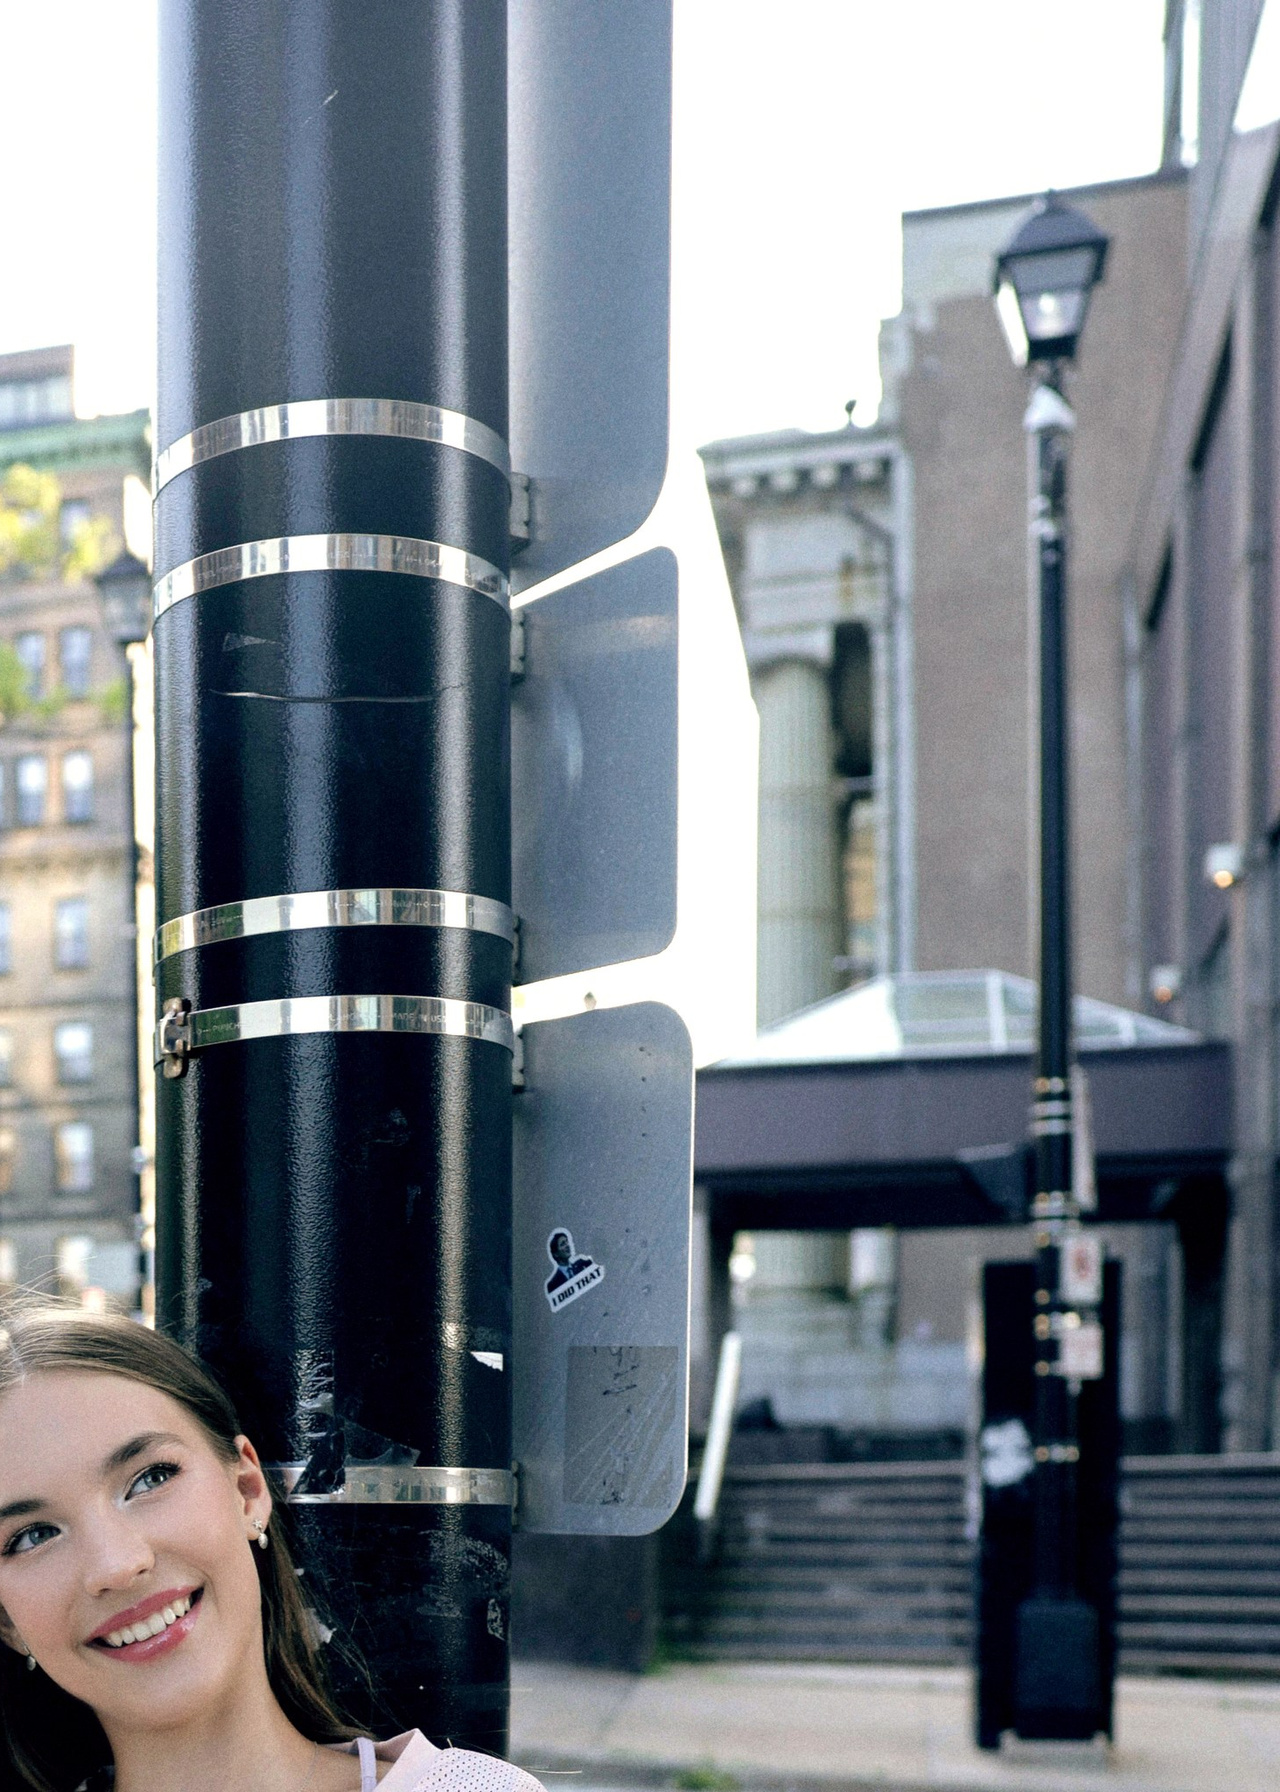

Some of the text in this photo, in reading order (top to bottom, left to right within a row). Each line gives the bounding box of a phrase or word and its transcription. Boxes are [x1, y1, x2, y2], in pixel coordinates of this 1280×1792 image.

[552, 1267, 601, 1307] I DID THAT
